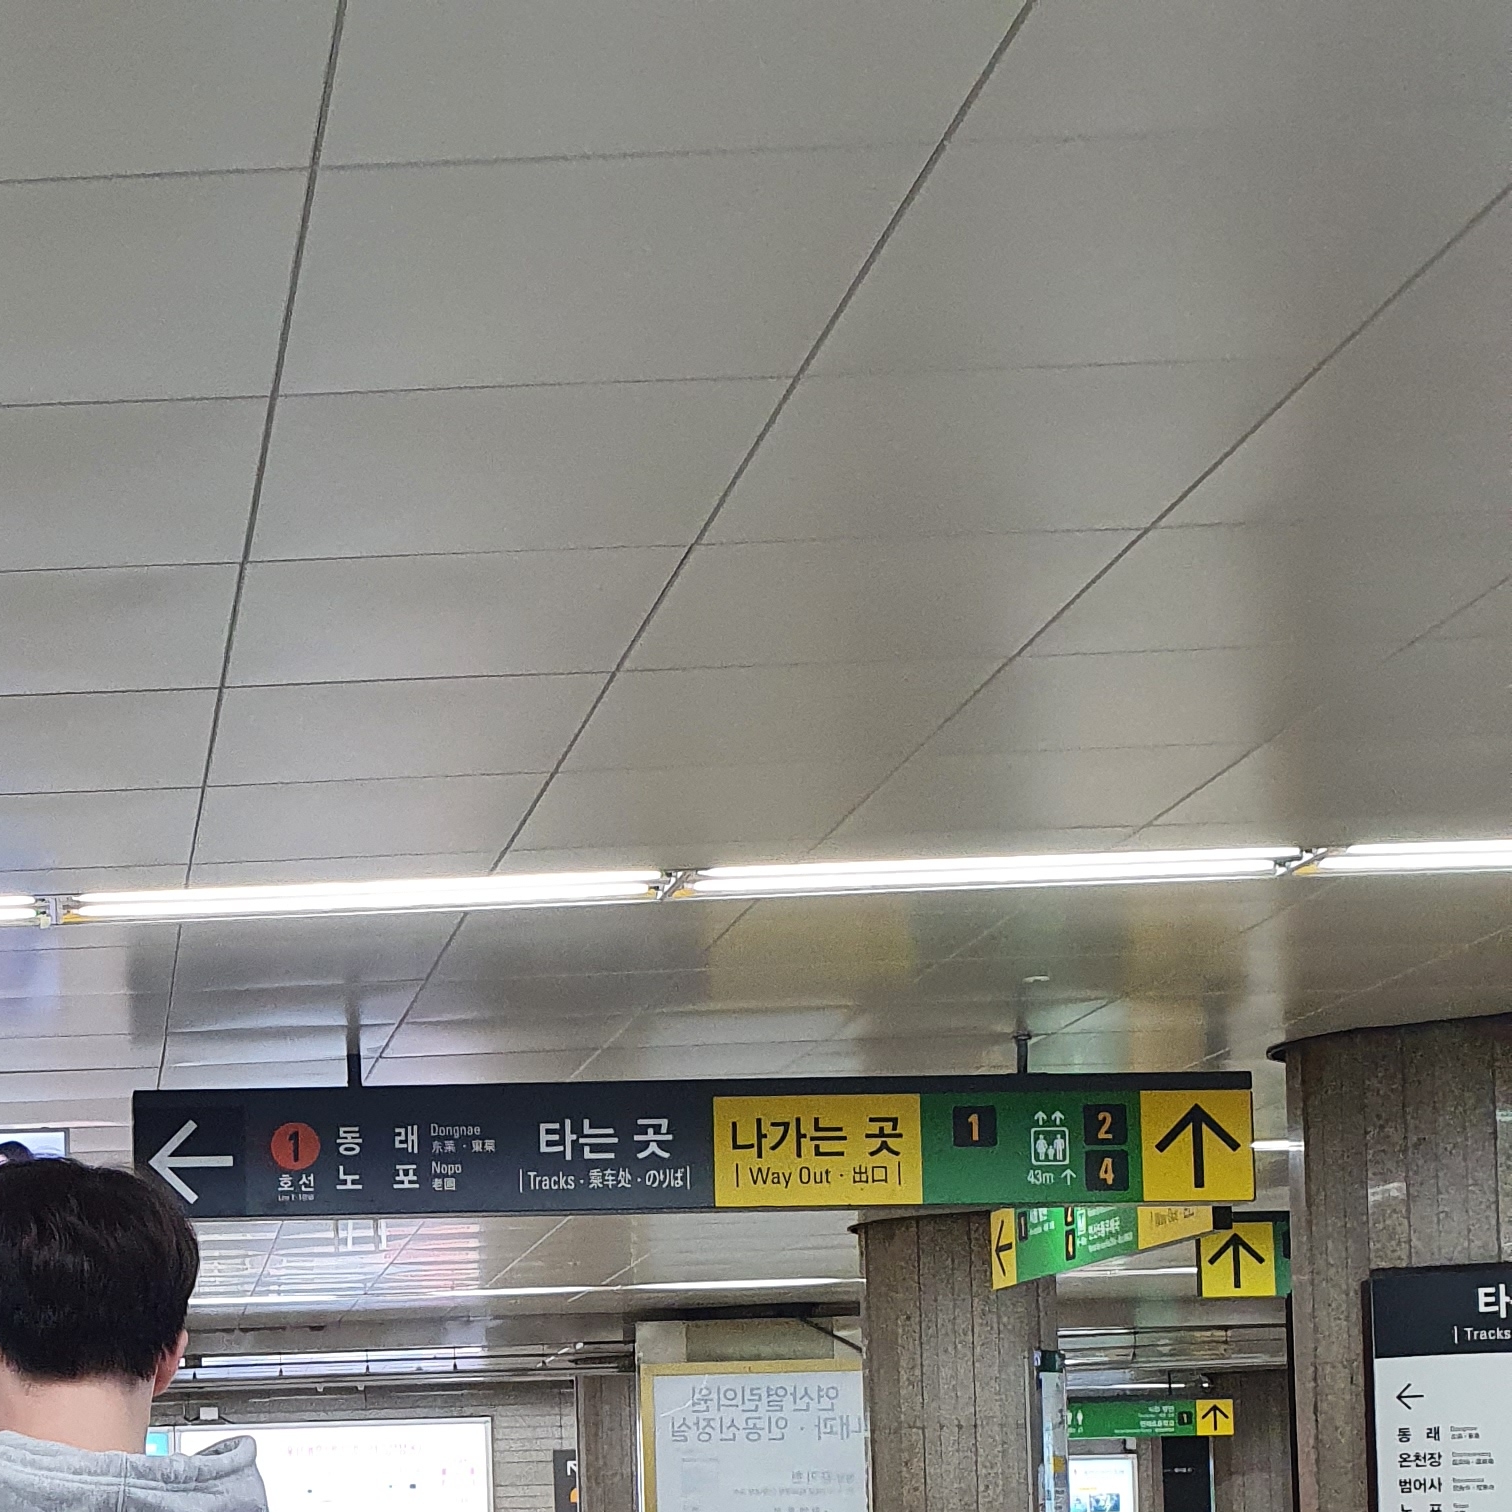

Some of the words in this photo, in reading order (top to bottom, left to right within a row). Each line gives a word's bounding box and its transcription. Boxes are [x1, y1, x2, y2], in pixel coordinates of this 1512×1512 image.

[430, 1123, 481, 1138] Dongnae
[730, 1115, 849, 1159] 나가는
[864, 1115, 904, 1158] 곳
[967, 1112, 980, 1143] 1
[1097, 1111, 1113, 1140] 2
[288, 1130, 299, 1163] 1
[539, 1118, 619, 1161] 타는
[633, 1118, 673, 1159] 곳
[431, 1161, 462, 1175] Nopo
[527, 1170, 576, 1190] Tracks
[588, 1167, 632, 1190] 乘车处
[645, 1167, 685, 1188] のりば
[749, 1166, 793, 1190] Way
[798, 1165, 832, 1187] Out
[851, 1164, 889, 1186] 出口
[1026, 1169, 1055, 1186] 43m
[1097, 1156, 1115, 1185] 4
[1477, 1283, 1512, 1319] 타
[1463, 1327, 1512, 1341] Tracks
[1398, 1451, 1442, 1468] 온천장
[1398, 1477, 1442, 1494] 범어사
